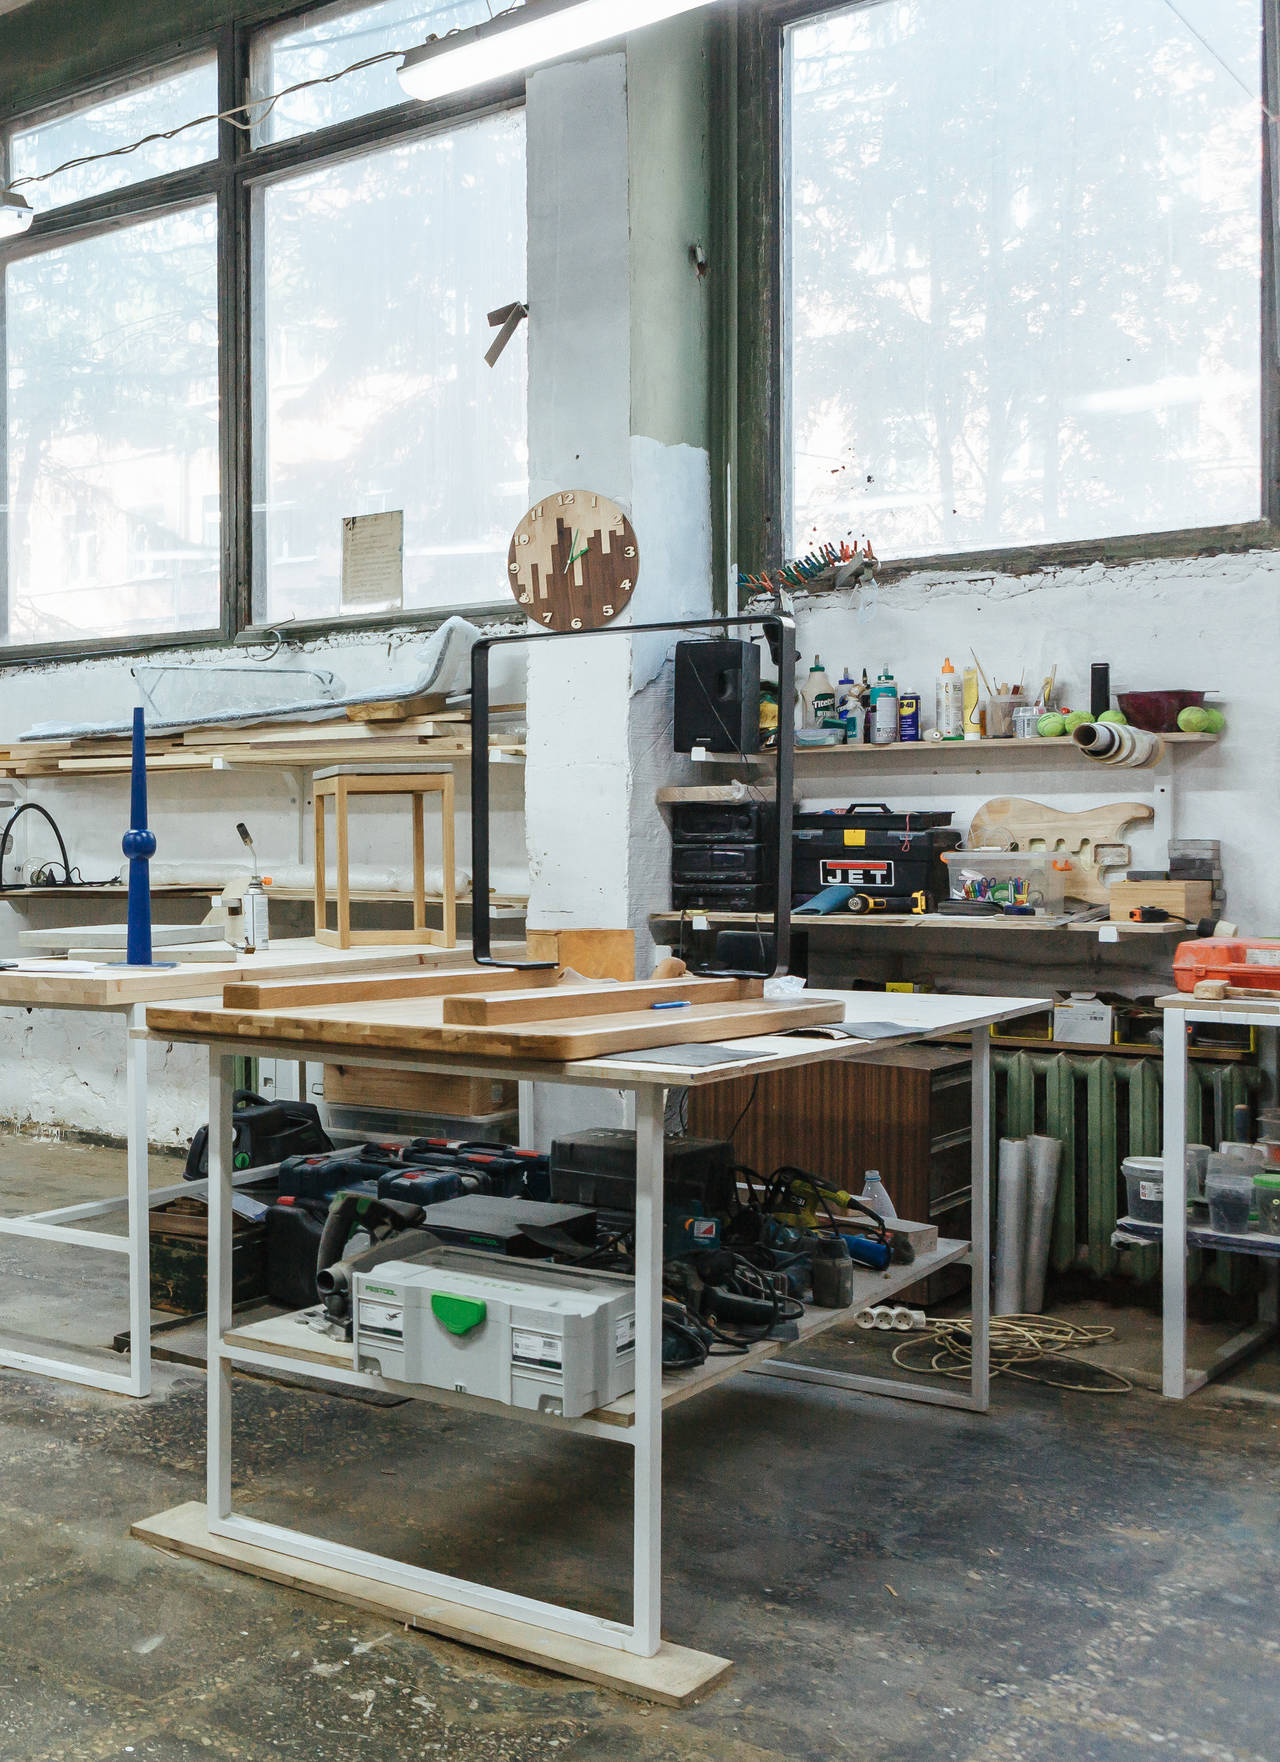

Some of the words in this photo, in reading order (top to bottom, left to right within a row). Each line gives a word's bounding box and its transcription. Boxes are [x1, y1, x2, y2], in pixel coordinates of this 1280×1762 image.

[557, 493, 575, 506] 12
[591, 495, 597, 508] 1
[531, 506, 543, 521] 11
[610, 512, 623, 525] 2
[514, 534, 530, 546] 10
[624, 546, 636, 558] 3
[509, 563, 519, 574] 9
[620, 579, 631, 591] 4
[519, 592, 530, 604] 8
[602, 605, 614, 616] 5
[542, 612, 553, 624] 7
[570, 618, 583, 630] 6
[827, 869, 887, 884] JET
[365, 1285, 397, 1297] FESTOOL
